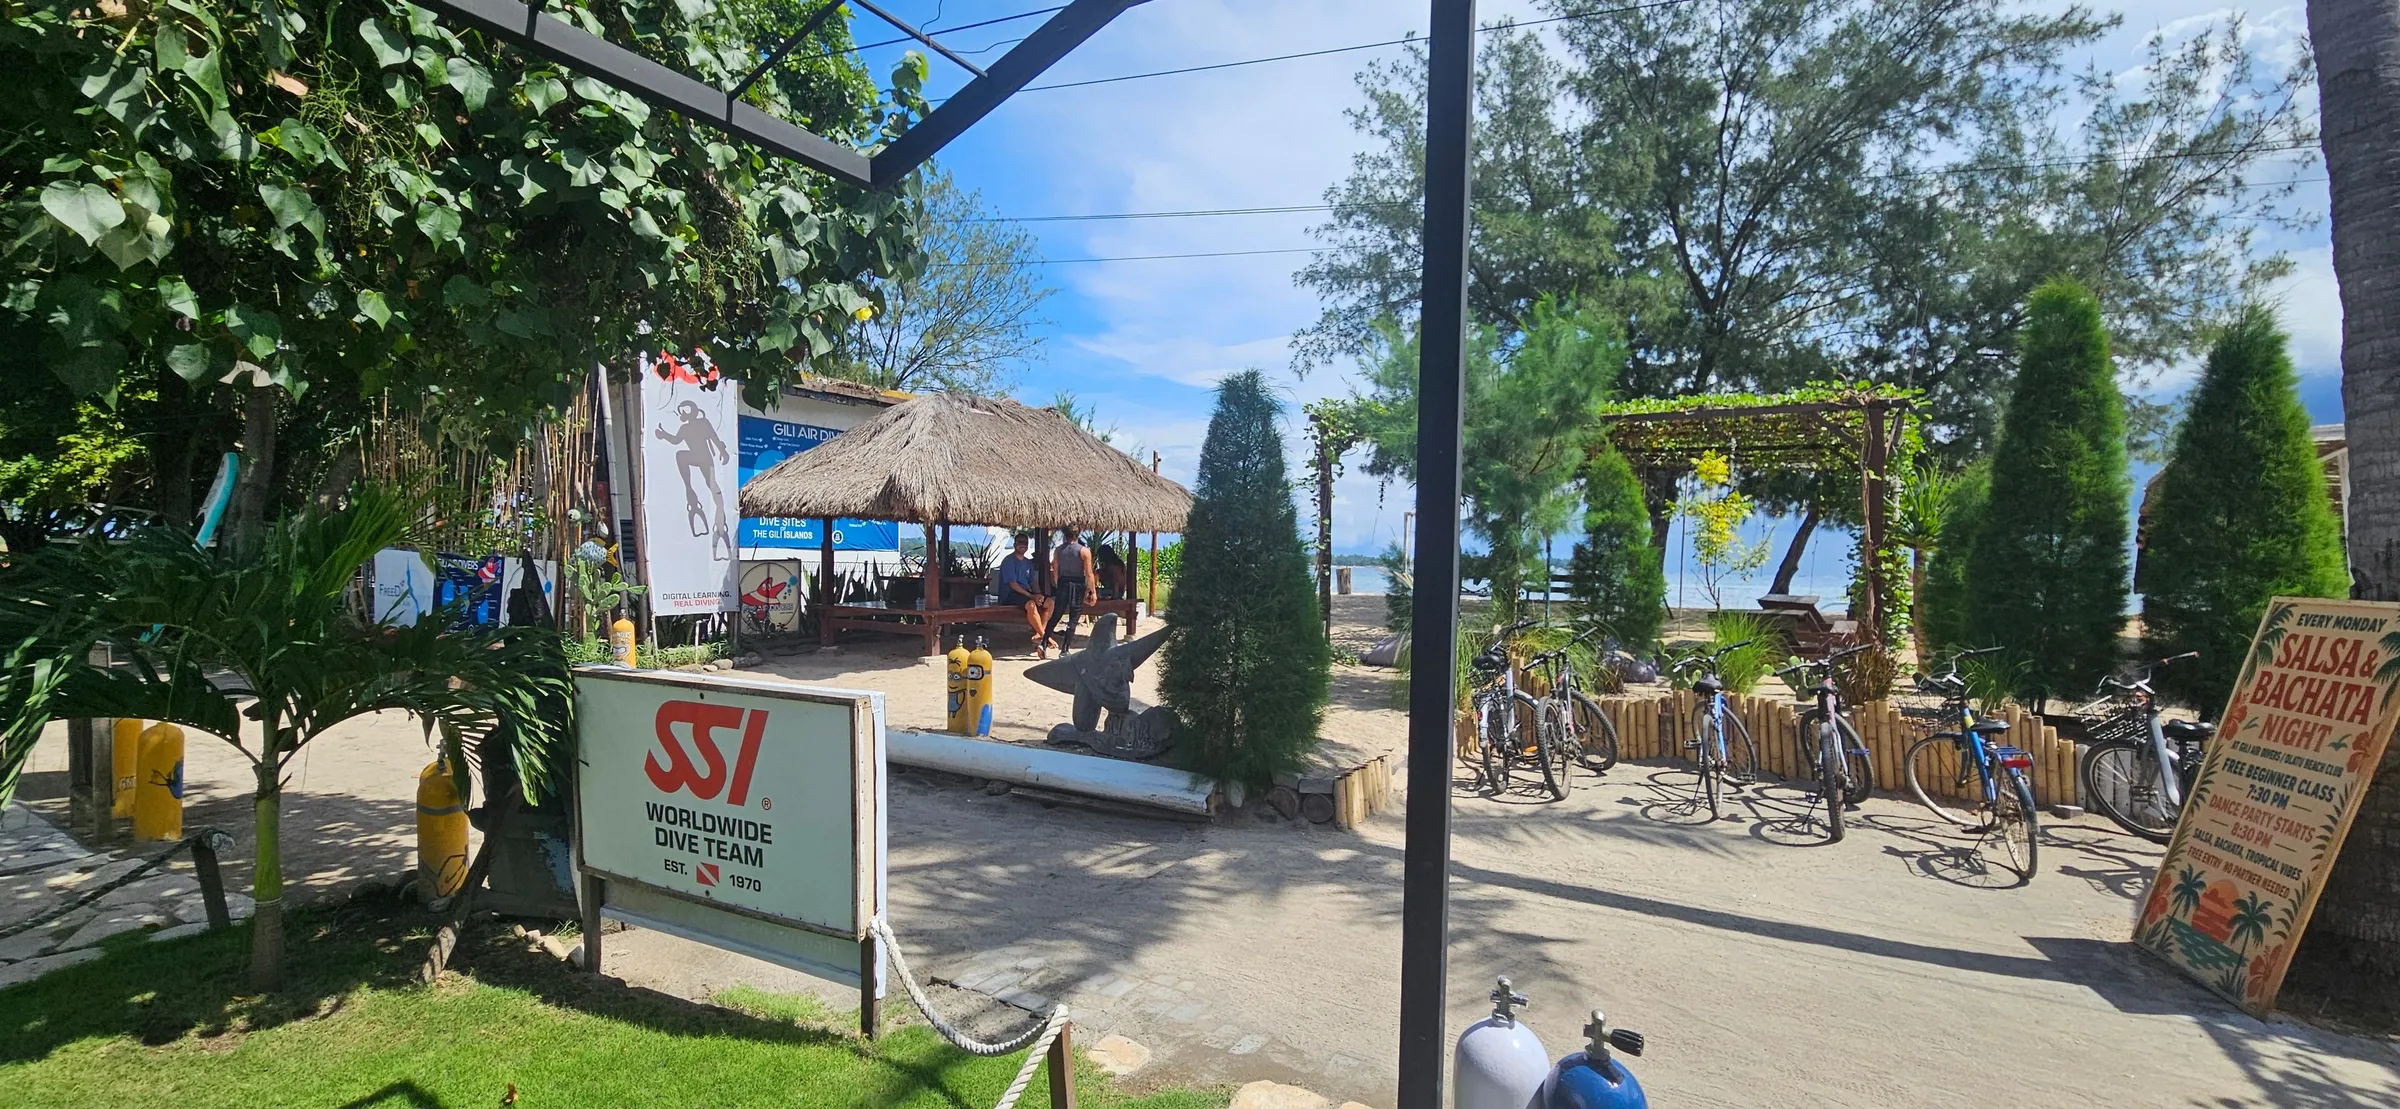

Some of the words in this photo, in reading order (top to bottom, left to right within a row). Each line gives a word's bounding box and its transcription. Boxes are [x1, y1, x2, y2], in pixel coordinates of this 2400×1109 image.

[773, 423, 795, 437] GILI
[798, 426, 818, 440] AIR
[753, 530, 767, 538] THE
[768, 530, 783, 539] GILI
[783, 531, 813, 540] ISLANDS
[759, 517, 779, 527] DIVE
[782, 517, 806, 528] SITES
[662, 592, 691, 600] DIGITAL
[693, 590, 732, 599] LEARNING.
[674, 600, 693, 608] REAL
[2297, 613, 2333, 629] EVERY
[2333, 615, 2387, 633] MONDAY
[2274, 633, 2364, 678] SALSA
[2249, 671, 2377, 726] BACHATA
[644, 700, 769, 806] SSI
[2258, 713, 2333, 753] NIGHT
[2222, 757, 2246, 776] FREE
[2245, 764, 2298, 791] BEGINNER
[2297, 779, 2336, 803] CLASS
[2245, 784, 2271, 804] 7:30
[2270, 792, 2290, 810] PM
[645, 801, 772, 845] WORLDWIDE
[2209, 794, 2242, 817] DANCE
[2240, 805, 2275, 828] PARTY
[2273, 816, 2316, 843] STARTS
[2231, 821, 2255, 842] 8:30
[2254, 830, 2274, 849] PM
[655, 827, 699, 854] DIVE
[704, 837, 763, 868] TEAM
[2192, 827, 2213, 846] SALSA,
[2214, 836, 2244, 859] BACHATA,
[2245, 849, 2280, 872] TROPICAL
[2280, 862, 2303, 880] VIBES
[664, 859, 688, 875] EST.
[729, 874, 761, 892] 1970
[2187, 846, 2202, 861] FREE
[2202, 852, 2223, 869] ENTRY
[2222, 860, 2234, 874] NO
[2231, 865, 2263, 886] PARTNER
[2261, 876, 2290, 898] NEEDED
